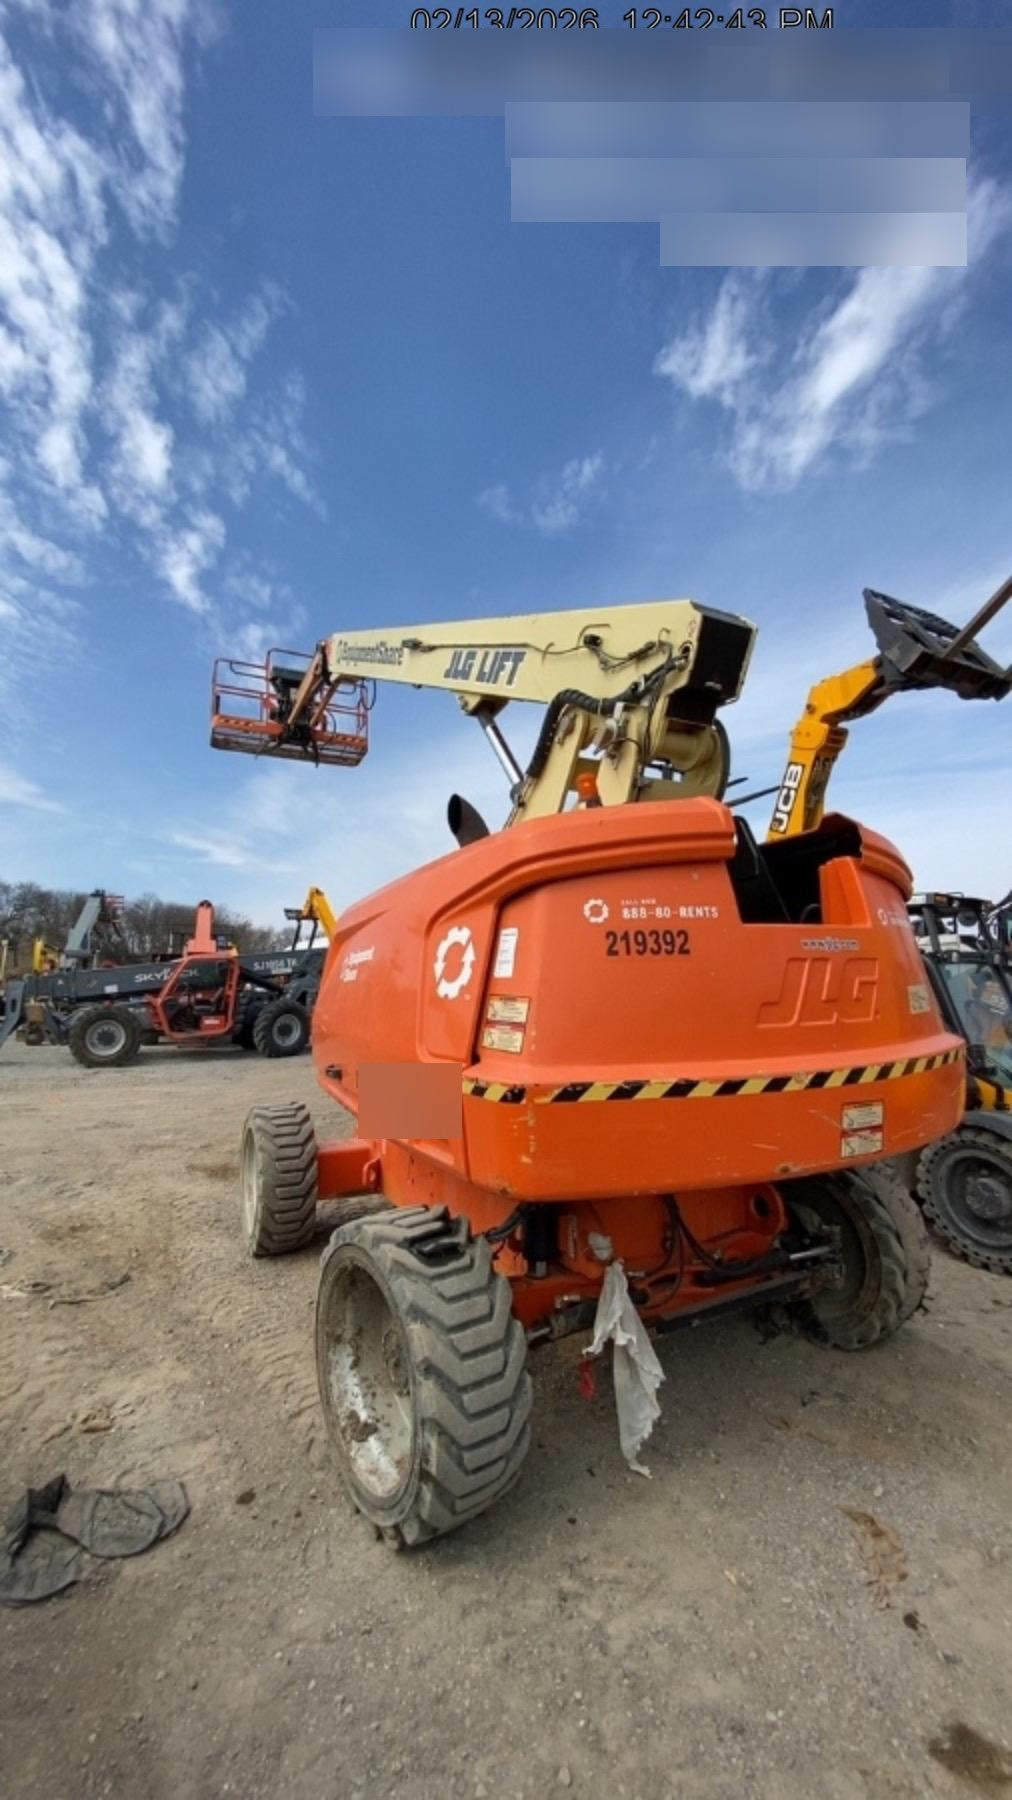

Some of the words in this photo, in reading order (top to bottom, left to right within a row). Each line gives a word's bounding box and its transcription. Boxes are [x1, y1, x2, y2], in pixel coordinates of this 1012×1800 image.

[444, 650, 475, 680] JLG
[476, 651, 526, 685] LIFT
[771, 763, 803, 832] JCB
[622, 906, 719, 919] 888-80-RENTS
[606, 930, 690, 956] 219392
[134, 967, 200, 982] SKYJCK
[757, 957, 879, 1028] JLG
